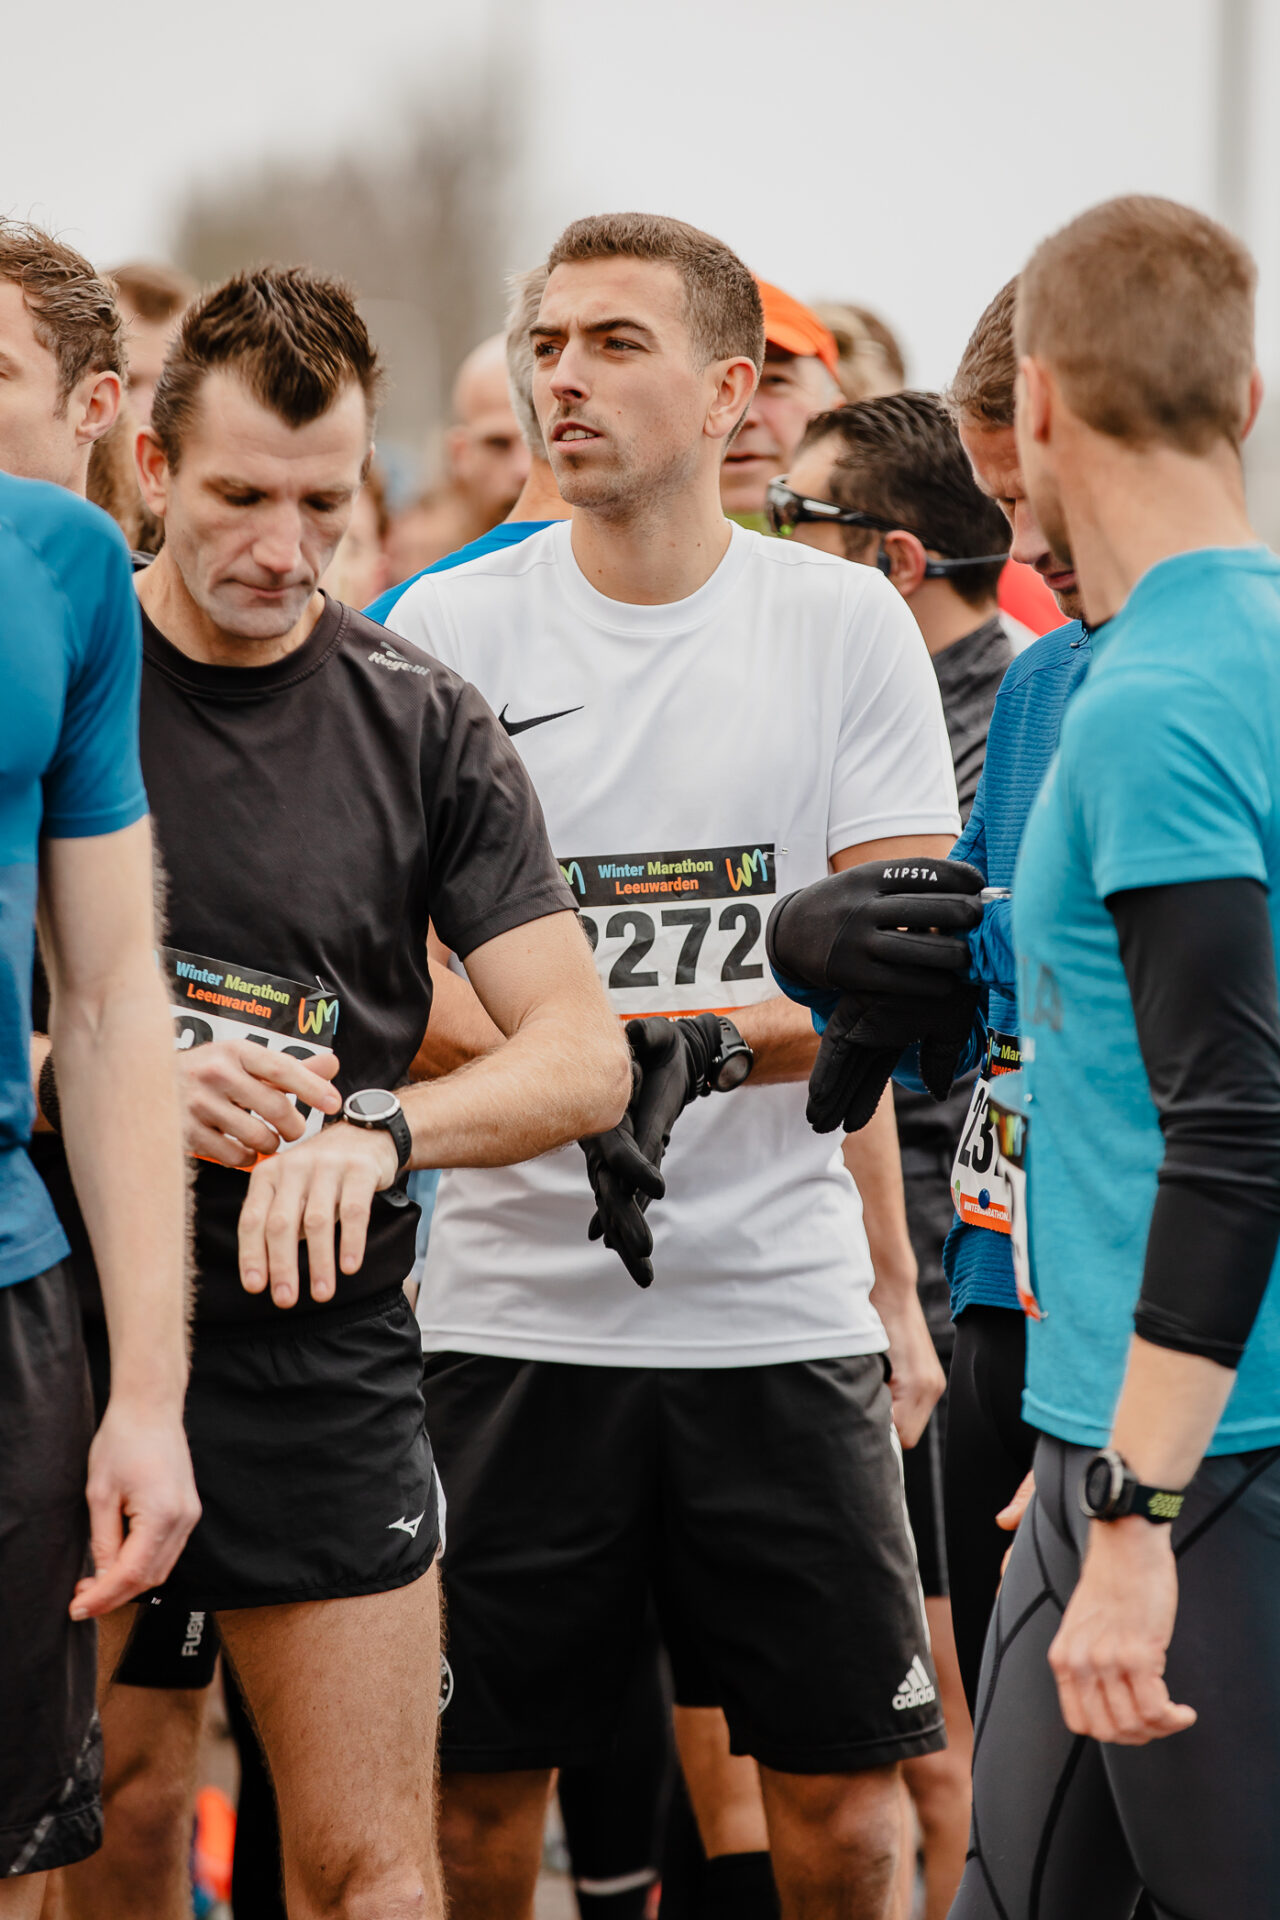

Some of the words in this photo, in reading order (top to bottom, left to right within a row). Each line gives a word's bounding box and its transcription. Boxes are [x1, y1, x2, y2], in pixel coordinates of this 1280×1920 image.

[598, 863, 645, 879] Winter
[647, 859, 714, 876] Marathon
[883, 867, 938, 881] KIPSTA
[615, 877, 699, 895] Leeuwarden
[176, 961, 223, 986] Winter
[224, 974, 290, 1005] Marathon
[187, 983, 272, 1019] Leeuwarden
[892, 1686, 936, 1710] adidas
